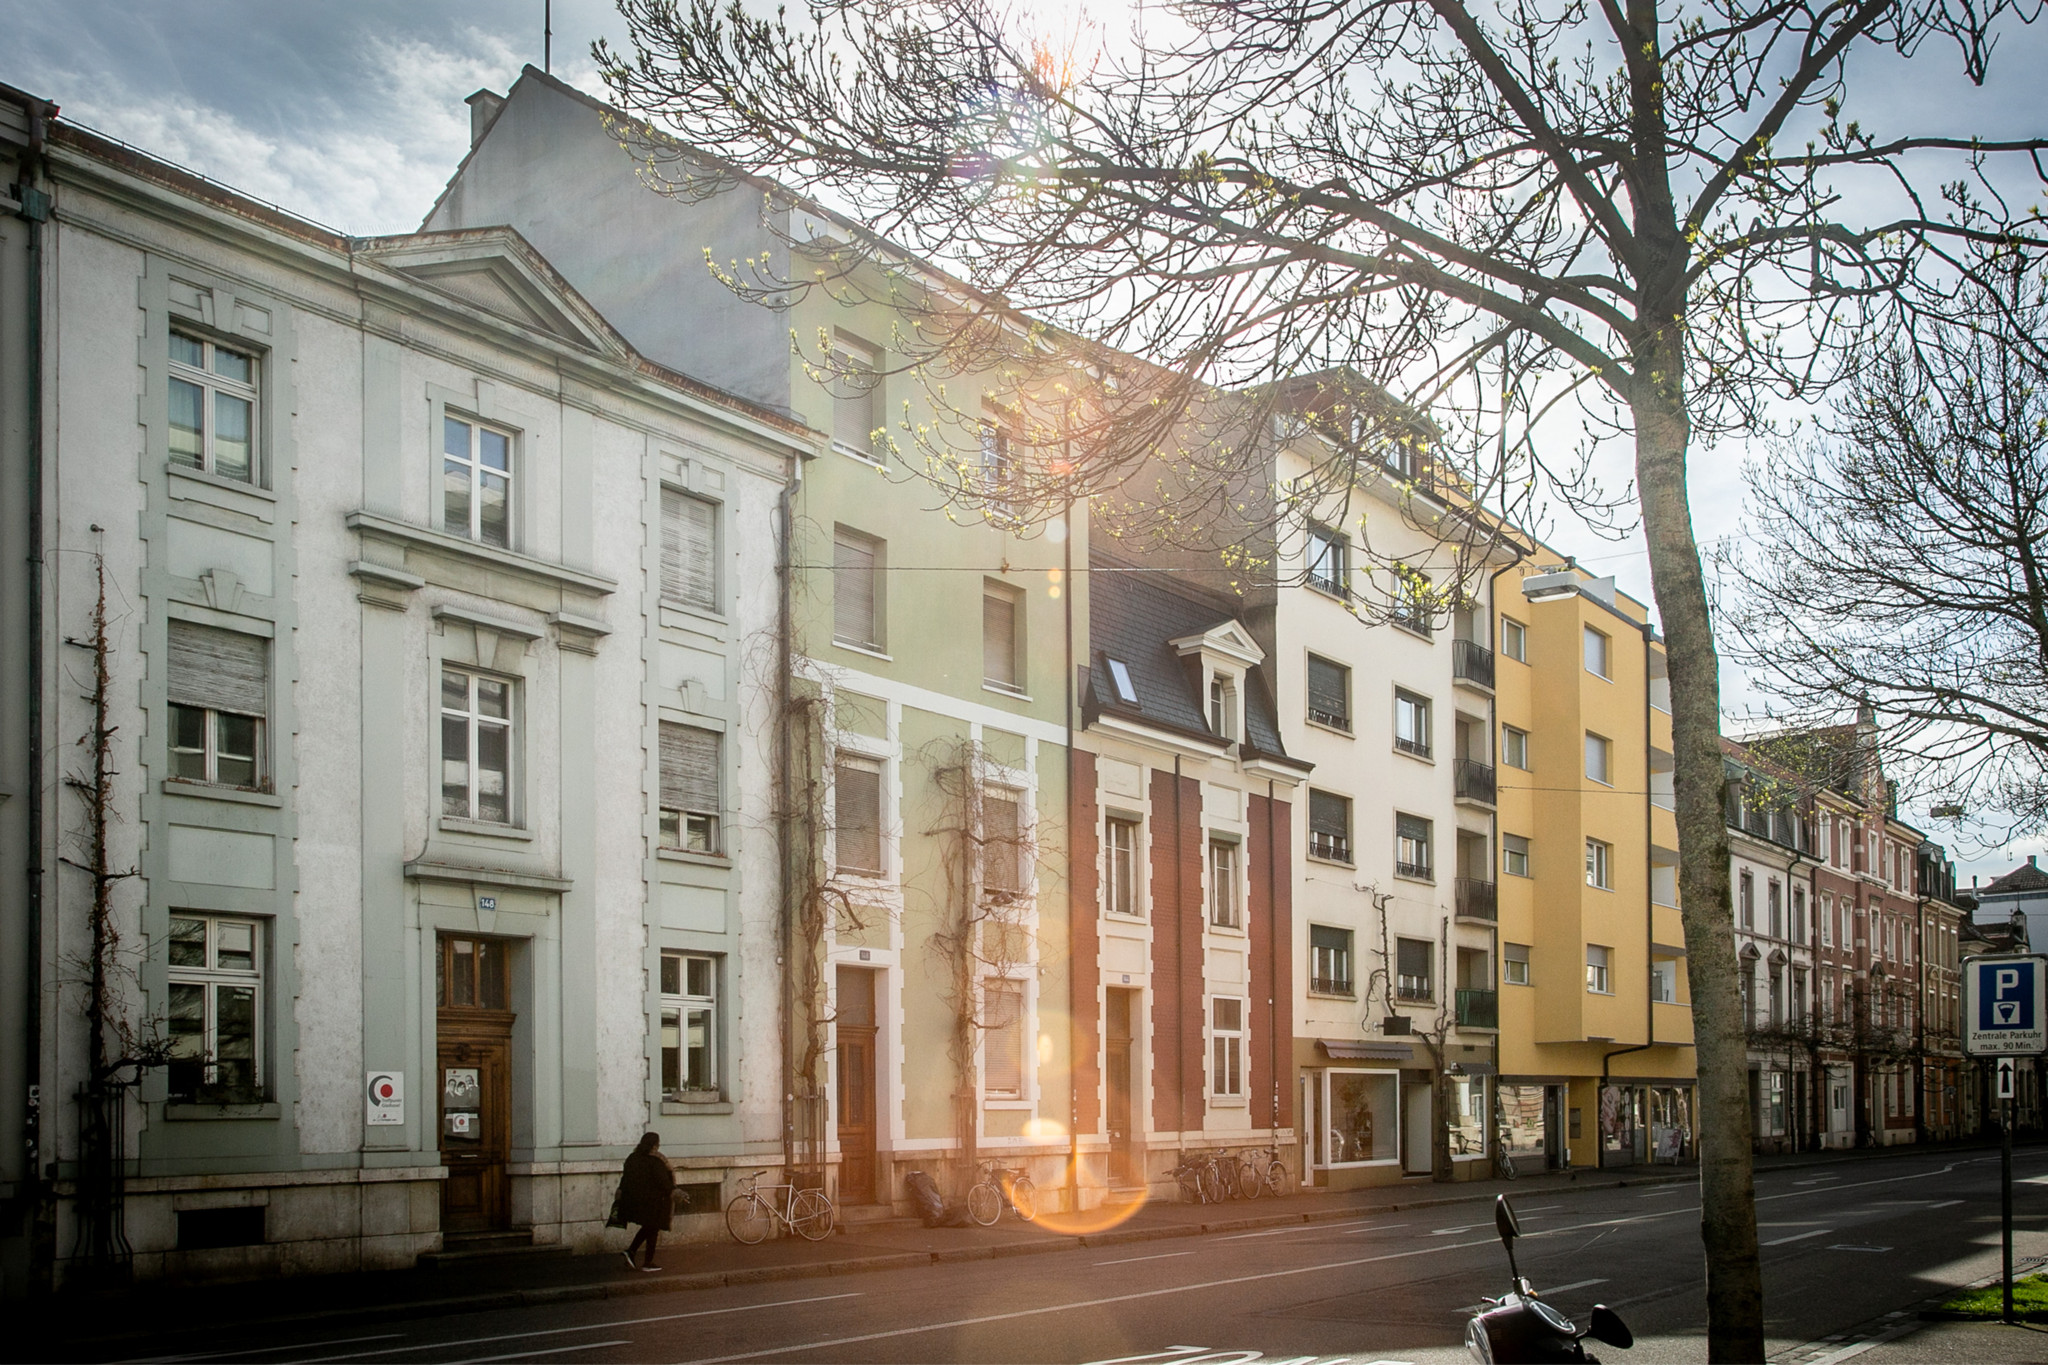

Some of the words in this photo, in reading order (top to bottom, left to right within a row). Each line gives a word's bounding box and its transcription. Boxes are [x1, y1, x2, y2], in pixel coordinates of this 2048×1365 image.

[481, 898, 494, 909] 148
[1996, 969, 2019, 1000] P
[1972, 1032, 2007, 1040] Zentrale
[2010, 1031, 2042, 1039] Parkuhr
[2003, 1042, 2014, 1050] 90
[2015, 1041, 2034, 1049] Min.
